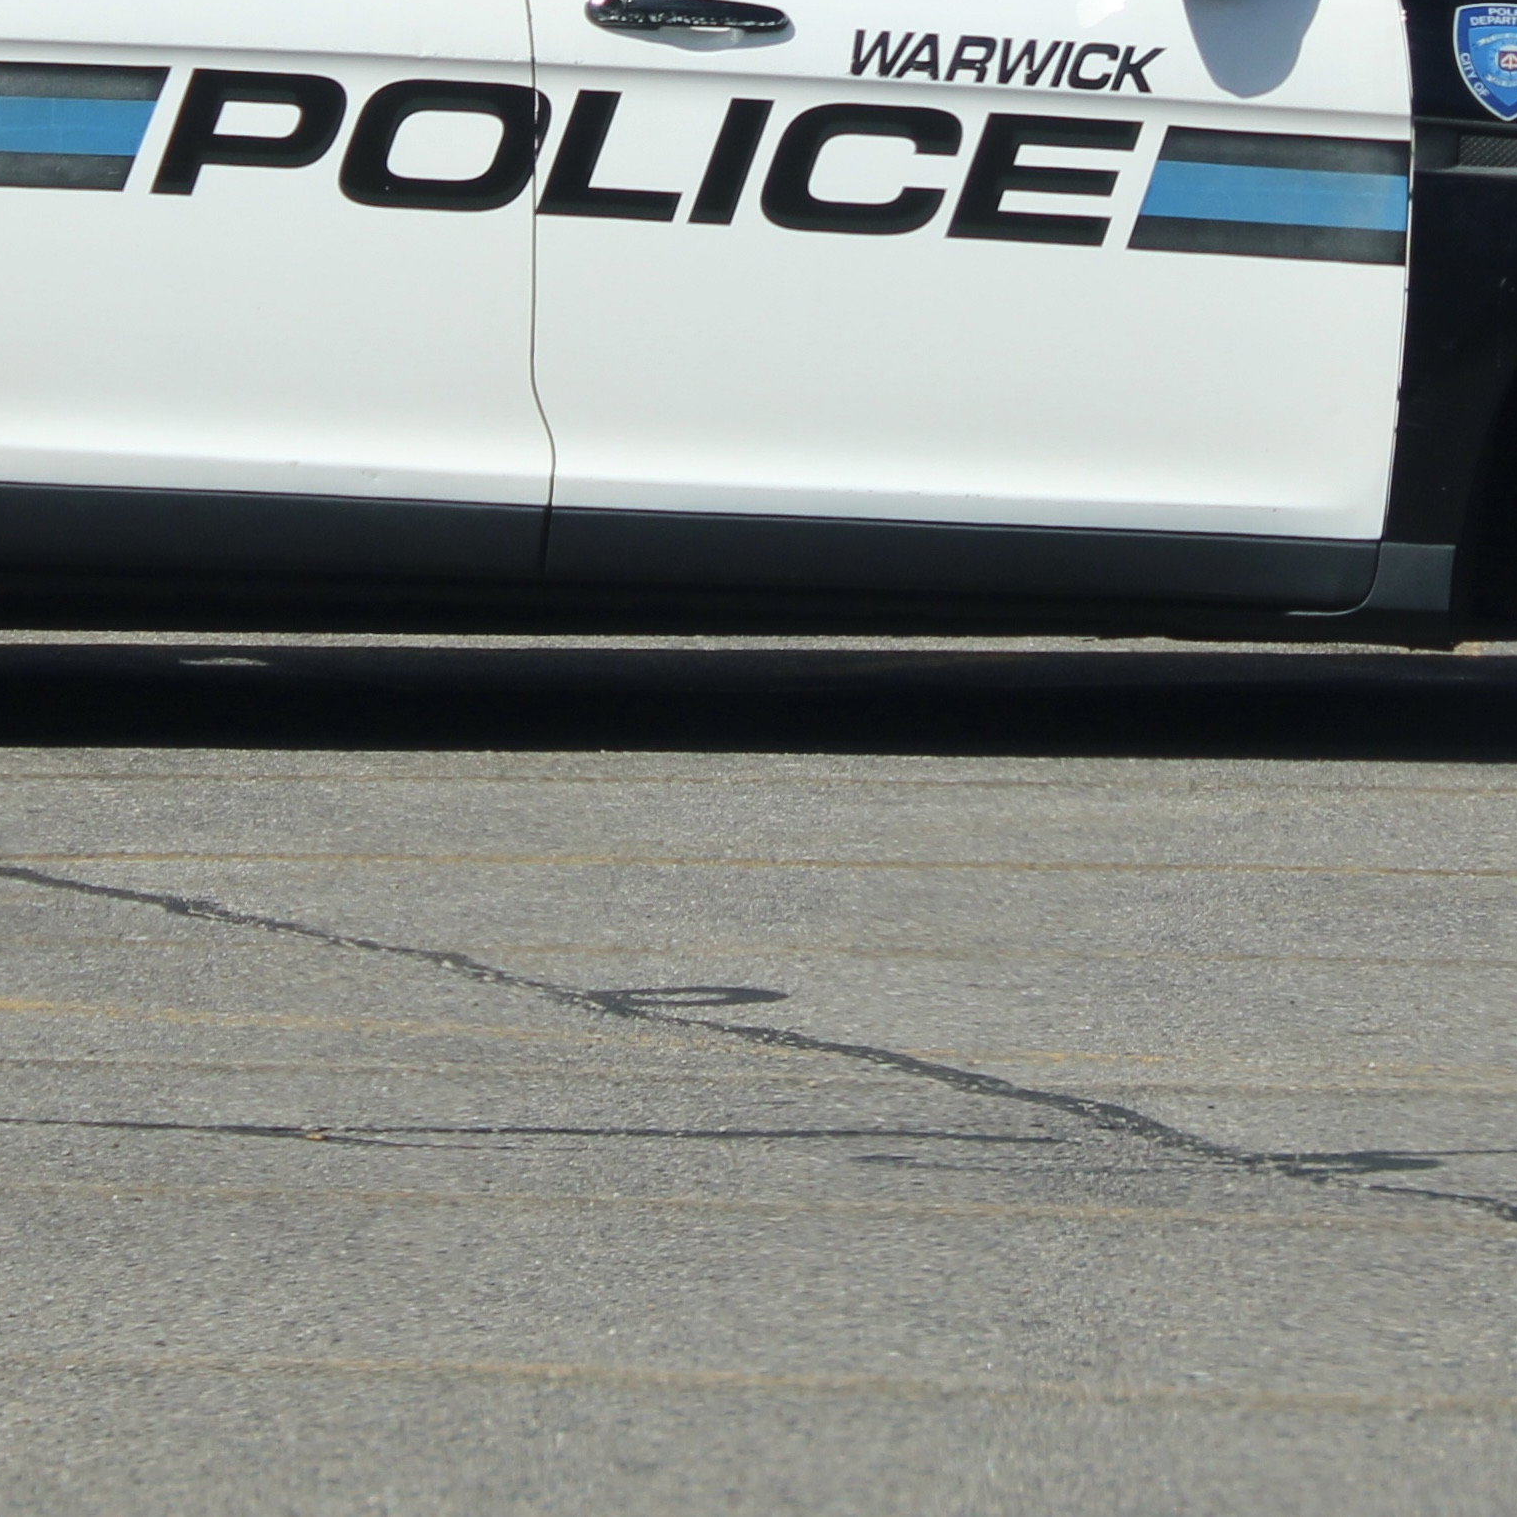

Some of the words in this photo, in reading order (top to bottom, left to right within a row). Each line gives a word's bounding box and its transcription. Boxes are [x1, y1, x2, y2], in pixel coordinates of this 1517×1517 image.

[849, 29, 1168, 93] WARWICK
[1459, 52, 1478, 80] CITY
[1473, 82, 1491, 98] OF
[151, 67, 1144, 247] POLICE
